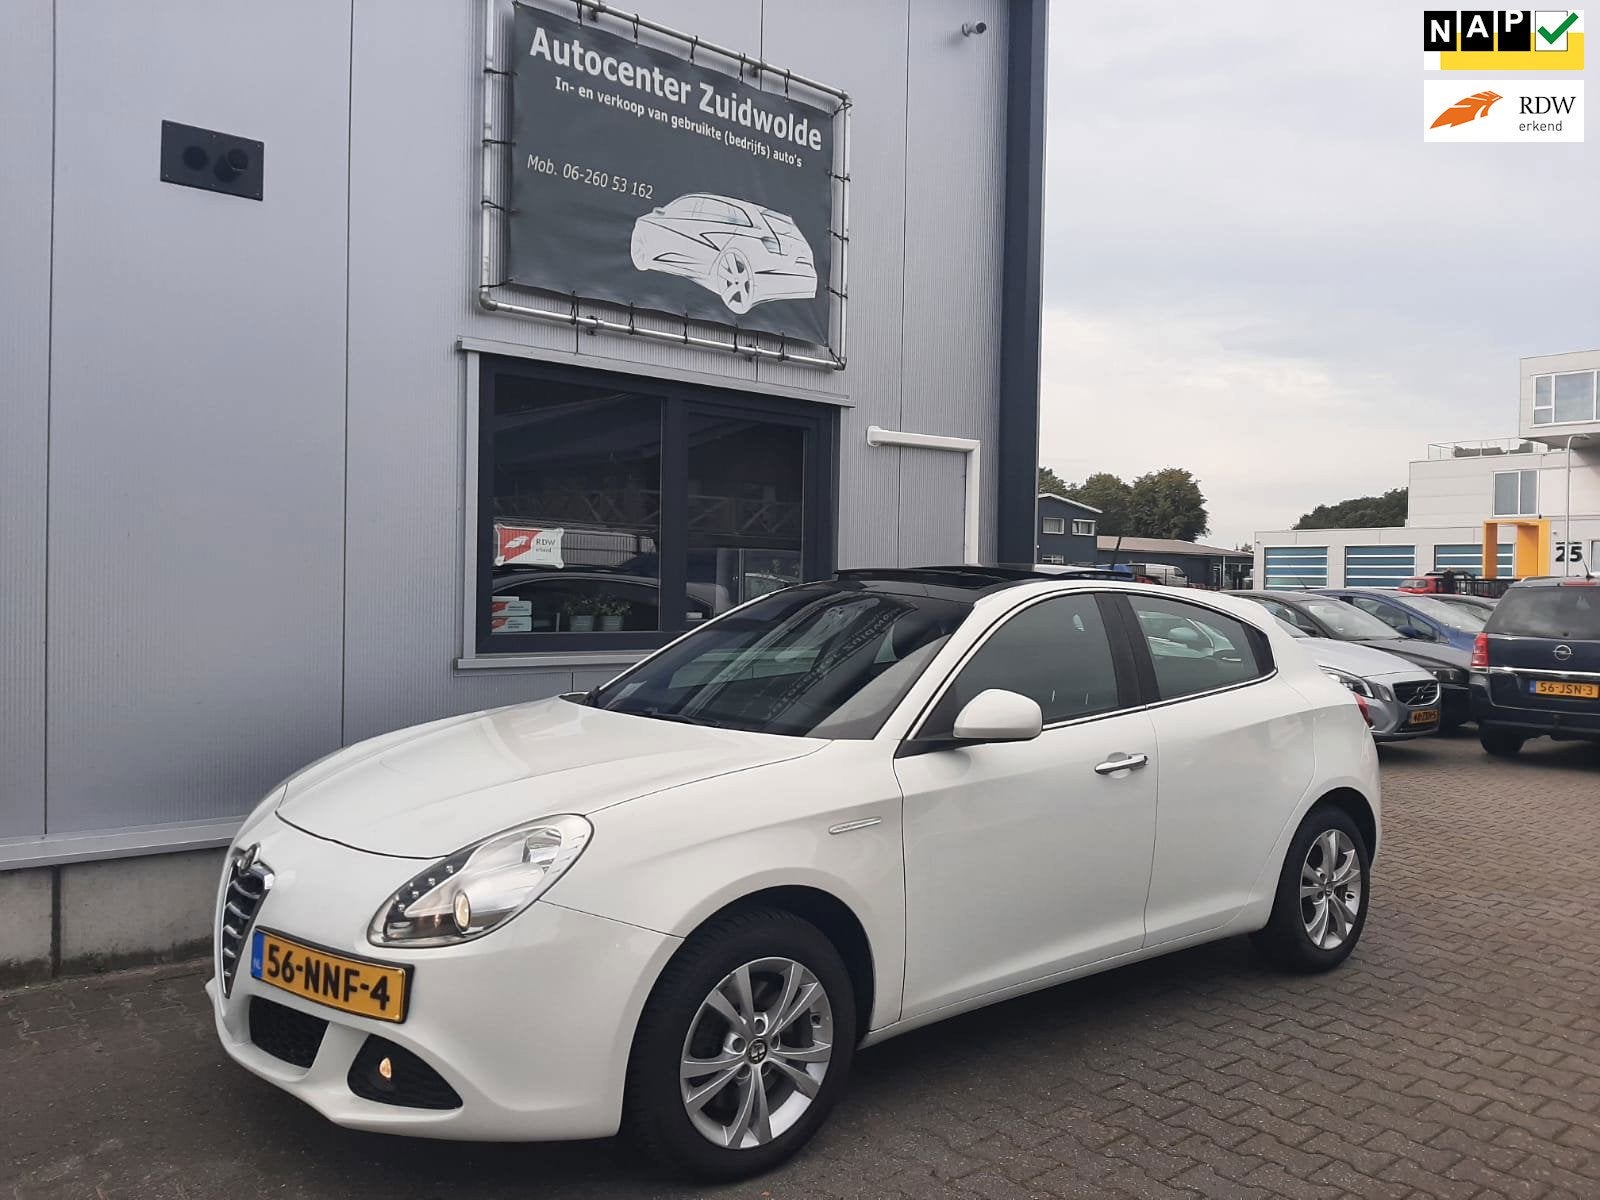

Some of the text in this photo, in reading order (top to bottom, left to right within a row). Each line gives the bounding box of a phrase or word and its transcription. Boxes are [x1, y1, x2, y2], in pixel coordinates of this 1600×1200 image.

[529, 26, 822, 151] Autocenter Zuidwolde
[554, 76, 802, 168] In- en verkoop van gebruikte (bedrijfs) auto's
[527, 153, 653, 200] Mob. 06-260 53 162
[1555, 545, 1583, 563] 25
[1539, 682, 1593, 696] 56-JSN-3
[266, 943, 391, 1012] 56-NNF-4
